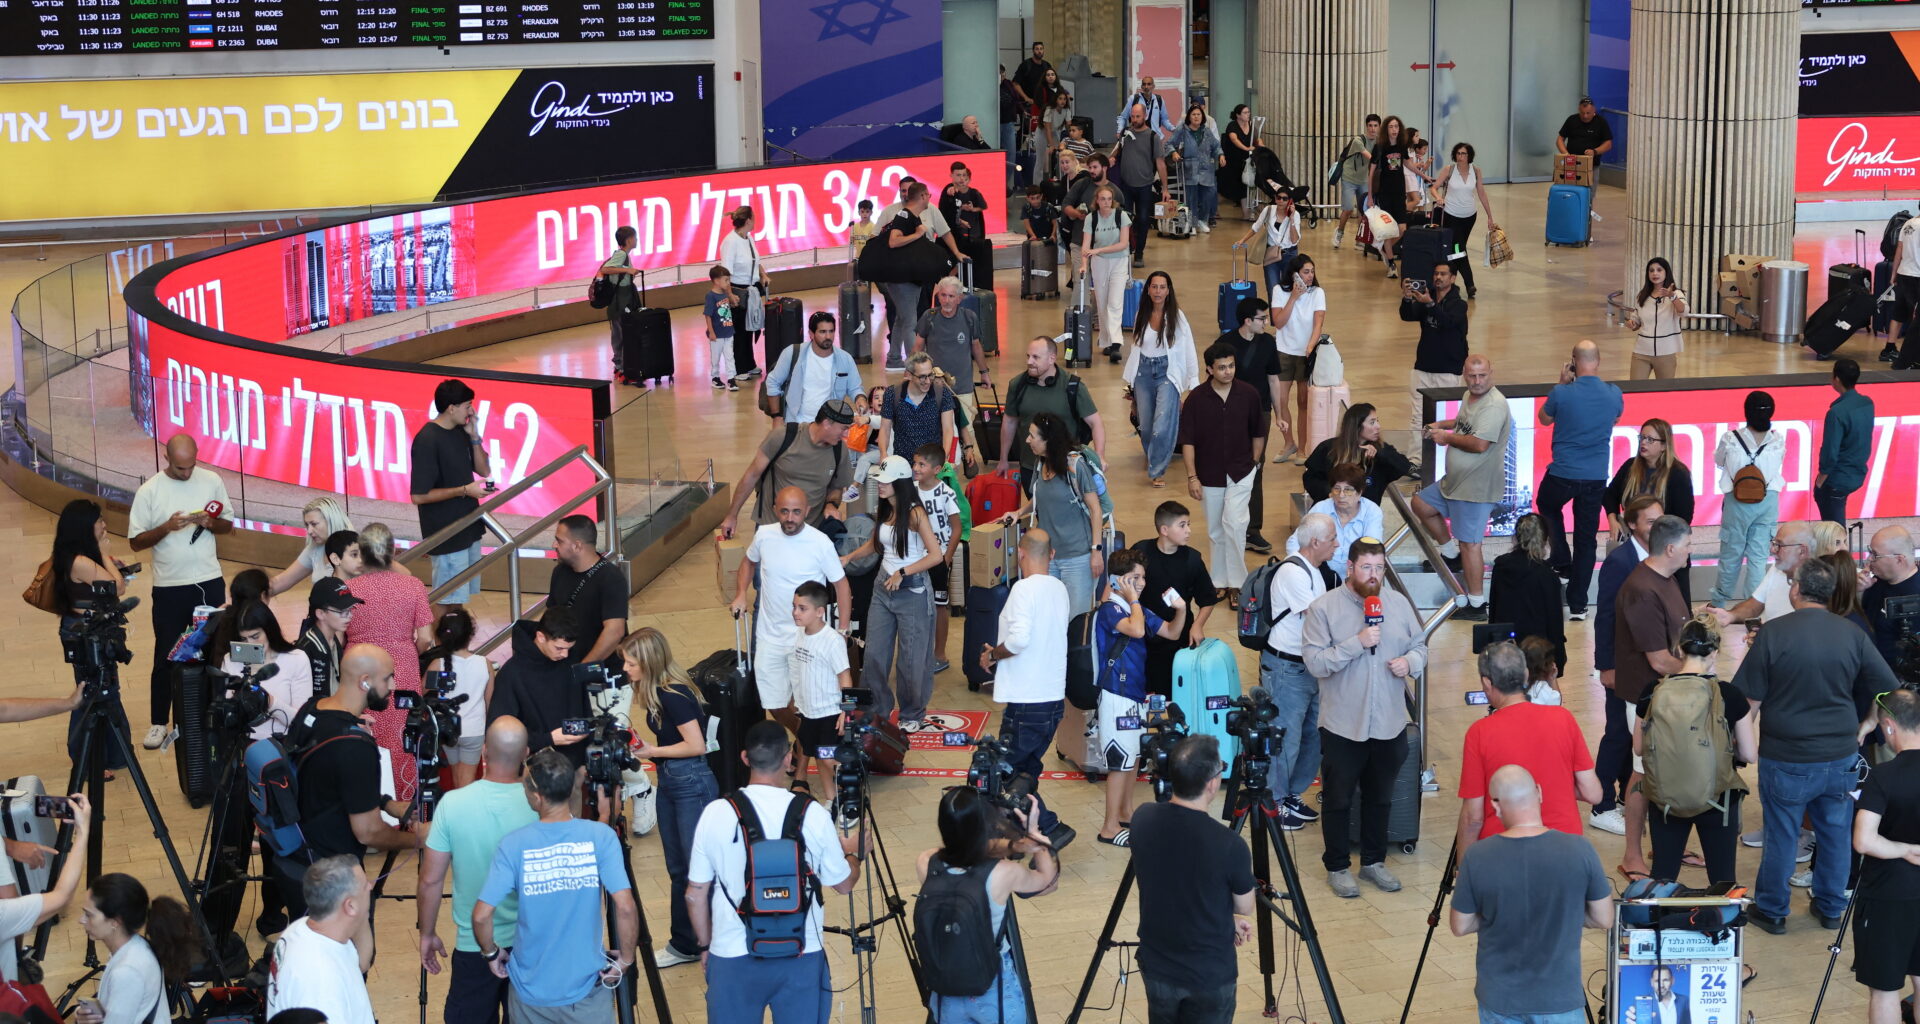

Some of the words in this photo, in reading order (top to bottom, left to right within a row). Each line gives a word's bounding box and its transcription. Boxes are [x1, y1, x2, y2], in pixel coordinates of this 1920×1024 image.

[1808, 54, 1846, 66] ולתמיד
[1848, 54, 1866, 68] כאן
[598, 90, 646, 104] ולתמיד
[650, 90, 674, 106] כאן
[60, 104, 122, 140] של
[136, 104, 248, 140] רגעים
[264, 97, 342, 135] לכם
[358, 98, 459, 132] בונים
[591, 118, 610, 127] גינדי
[0, 112, 52, 142] או
[556, 120, 589, 130] החזקות
[1853, 168, 1891, 179] החזקות
[1894, 168, 1916, 176] גינדי
[690, 182, 806, 246] מגדלי
[536, 196, 673, 270] מגורים
[168, 358, 266, 450] מגורים
[282, 377, 408, 475] מגדלי
[1370, 604, 1381, 613] 14
[763, 888, 789, 899] LiveU
[1701, 973, 1727, 990] 24
